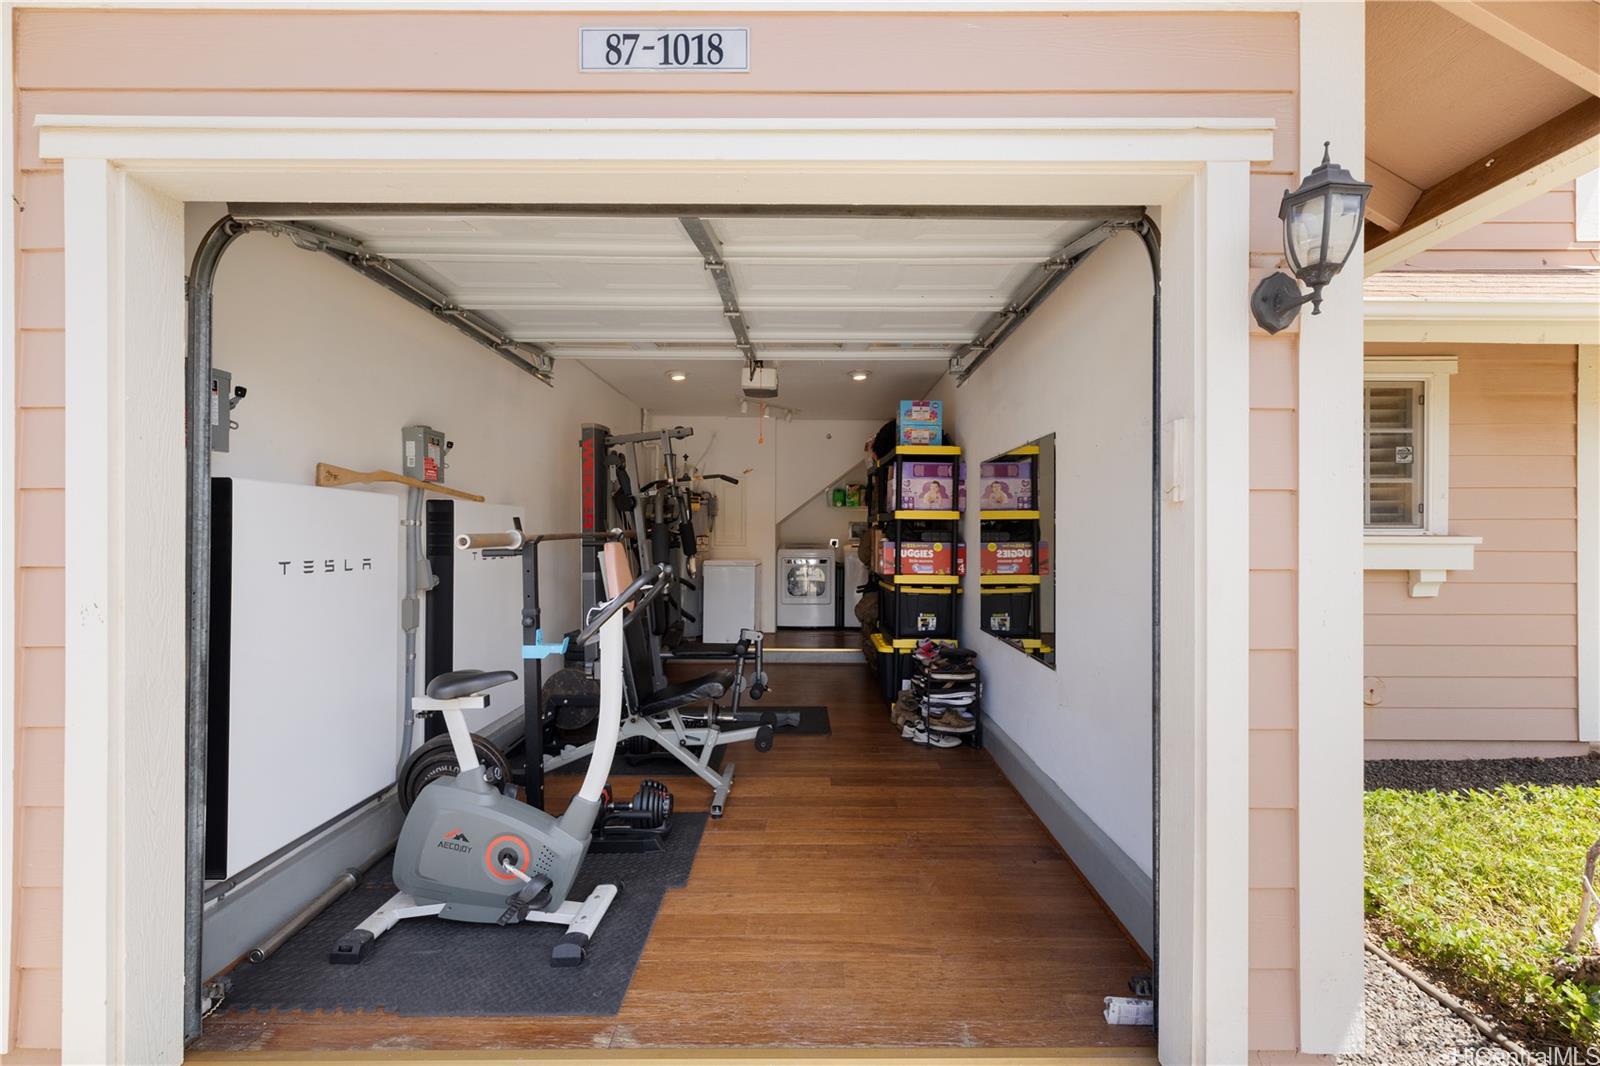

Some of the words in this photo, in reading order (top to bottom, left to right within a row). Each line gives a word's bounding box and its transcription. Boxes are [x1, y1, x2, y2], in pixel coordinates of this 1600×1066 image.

[605, 33, 724, 66] 87-1018
[893, 548, 934, 558] UGGIES
[277, 557, 372, 576] TESLA
[957, 563, 965, 573] 4
